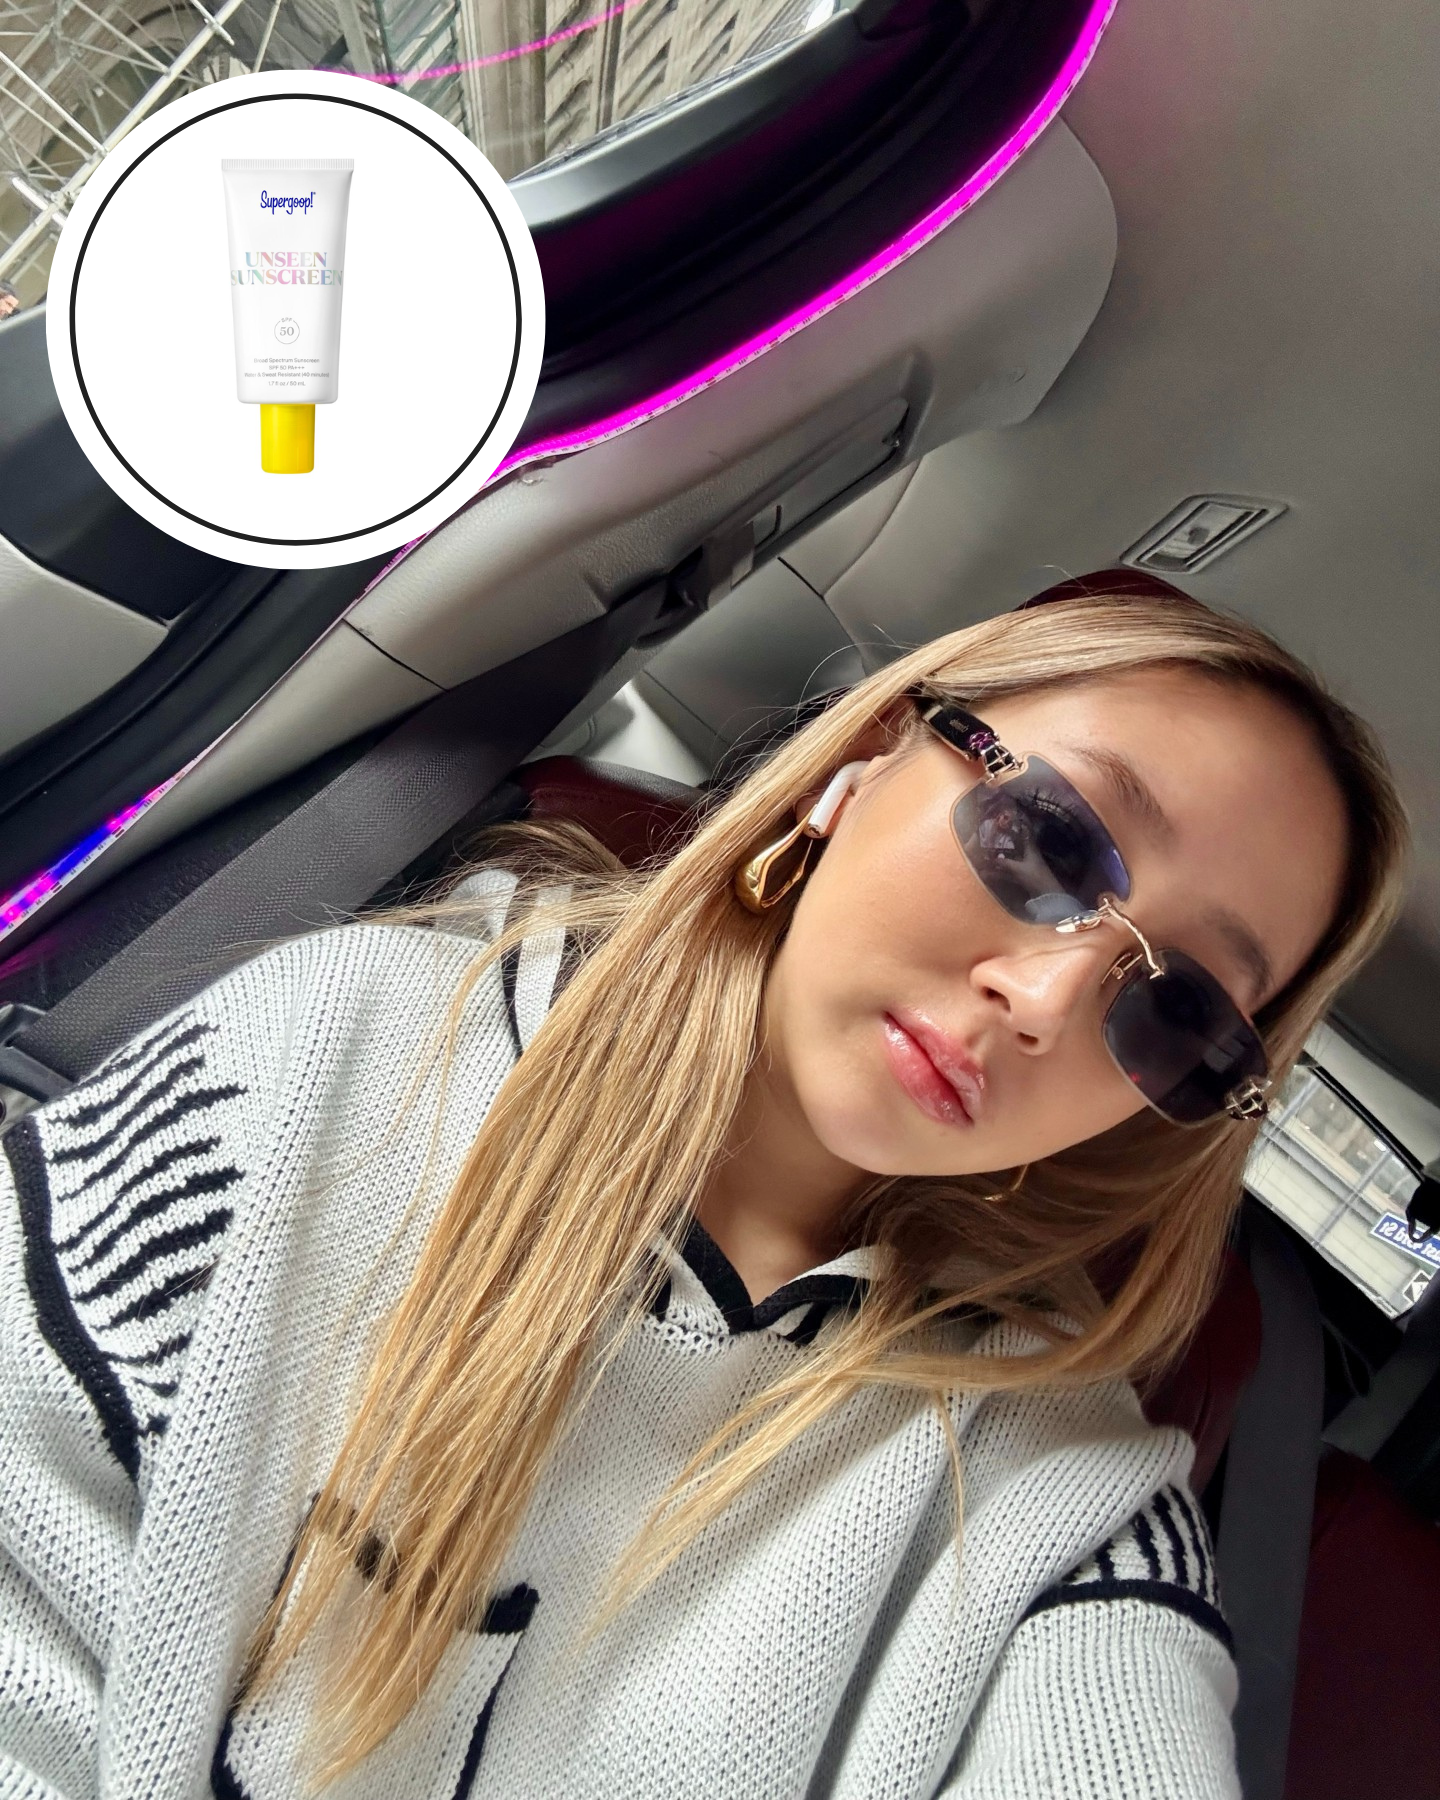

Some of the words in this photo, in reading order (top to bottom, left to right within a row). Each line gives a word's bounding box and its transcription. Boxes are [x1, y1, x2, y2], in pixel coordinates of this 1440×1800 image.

[260, 190, 314, 215] Supergoop!
[245, 251, 327, 268] UNSEEN
[230, 268, 343, 286] SUNSCREEN
[279, 326, 295, 336] 50
